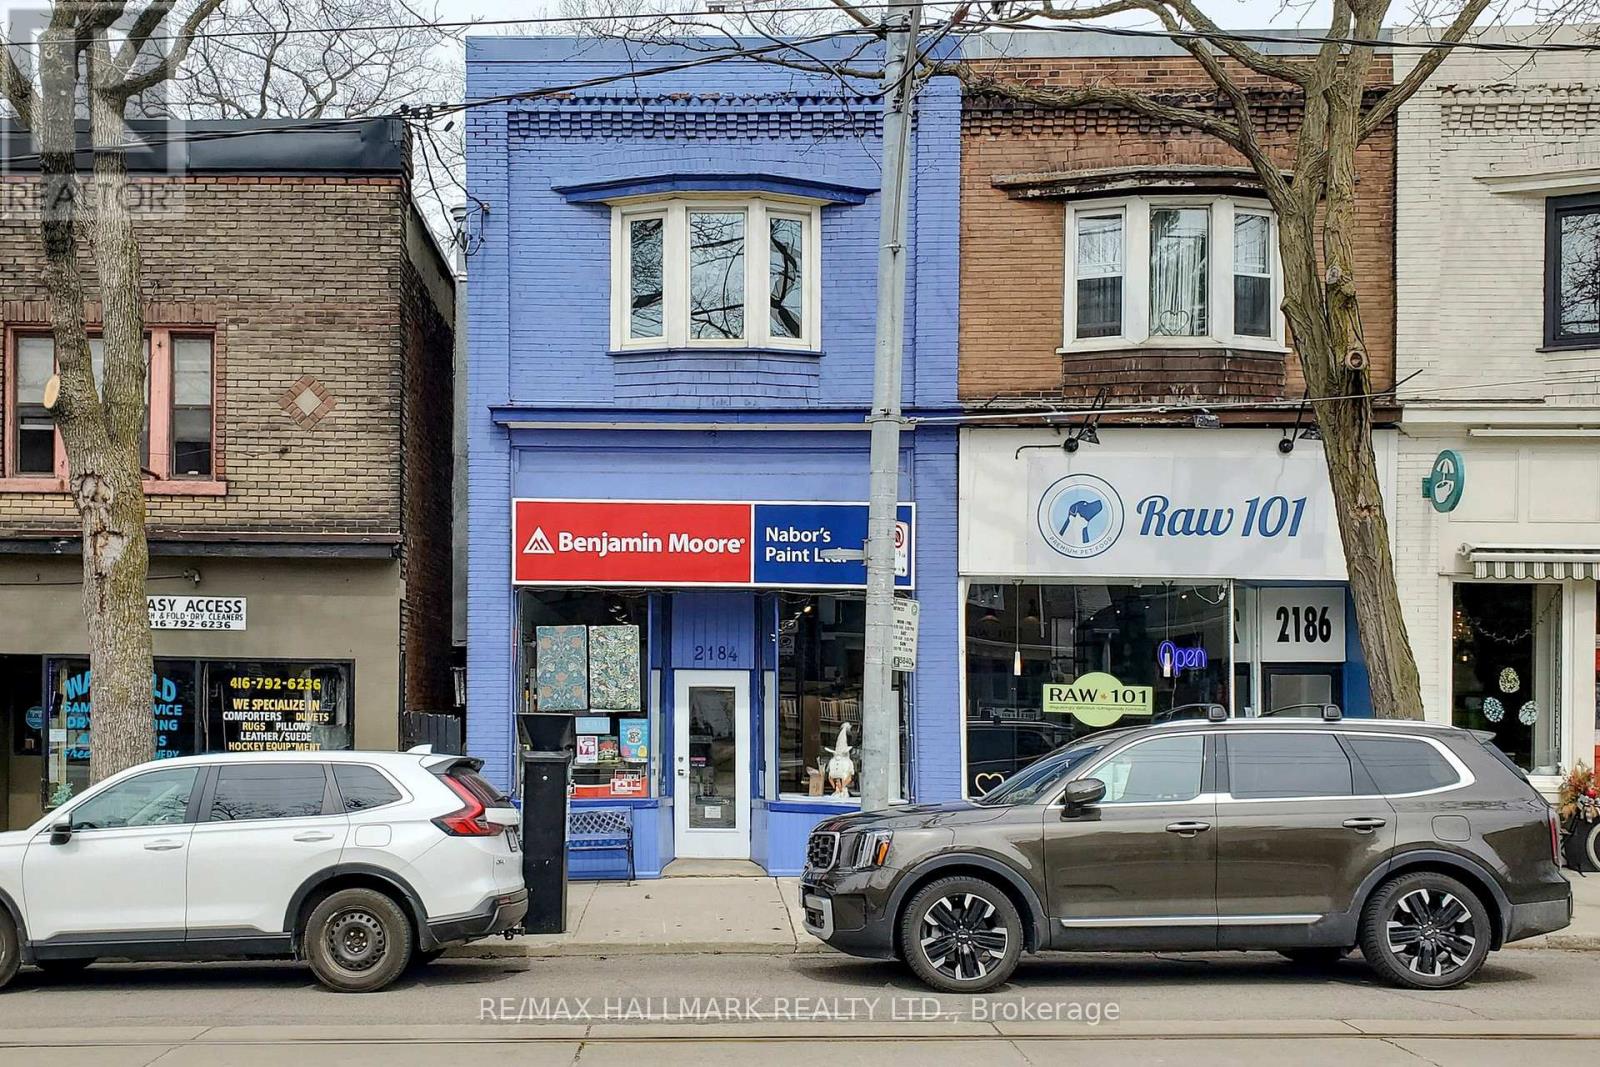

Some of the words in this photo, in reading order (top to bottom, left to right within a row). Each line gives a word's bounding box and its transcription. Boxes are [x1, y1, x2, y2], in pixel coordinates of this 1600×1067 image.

[1136, 495, 1234, 537] Raw
[1241, 495, 1308, 538] 101
[765, 527, 831, 543] Nabor's
[558, 531, 662, 557] Benjamin
[1049, 535, 1078, 554] PREMIUM
[1094, 536, 1113, 551] FOOD
[765, 546, 810, 563] Paint
[147, 599, 177, 612] ASY
[185, 599, 242, 613] ACCESS
[208, 613, 244, 621] CLEANERS
[1275, 606, 1332, 643] 2186
[694, 645, 738, 662] 2184
[1158, 640, 1208, 678] Open
[229, 677, 321, 690] 416-792-6236
[1049, 687, 1098, 703] RAW
[1110, 689, 1146, 704] 101
[64, 701, 92, 713] SAM
[232, 698, 250, 710] WE
[251, 698, 305, 711] SPECIALIZE
[308, 699, 320, 711] IN
[222, 711, 282, 721] COMFORTERS
[295, 712, 330, 722] DUVETS
[242, 721, 266, 731] RUGS
[275, 721, 312, 731] PILLOWS
[240, 731, 312, 742] LEATHER/SUEDE
[228, 741, 265, 752] HOCKEY
